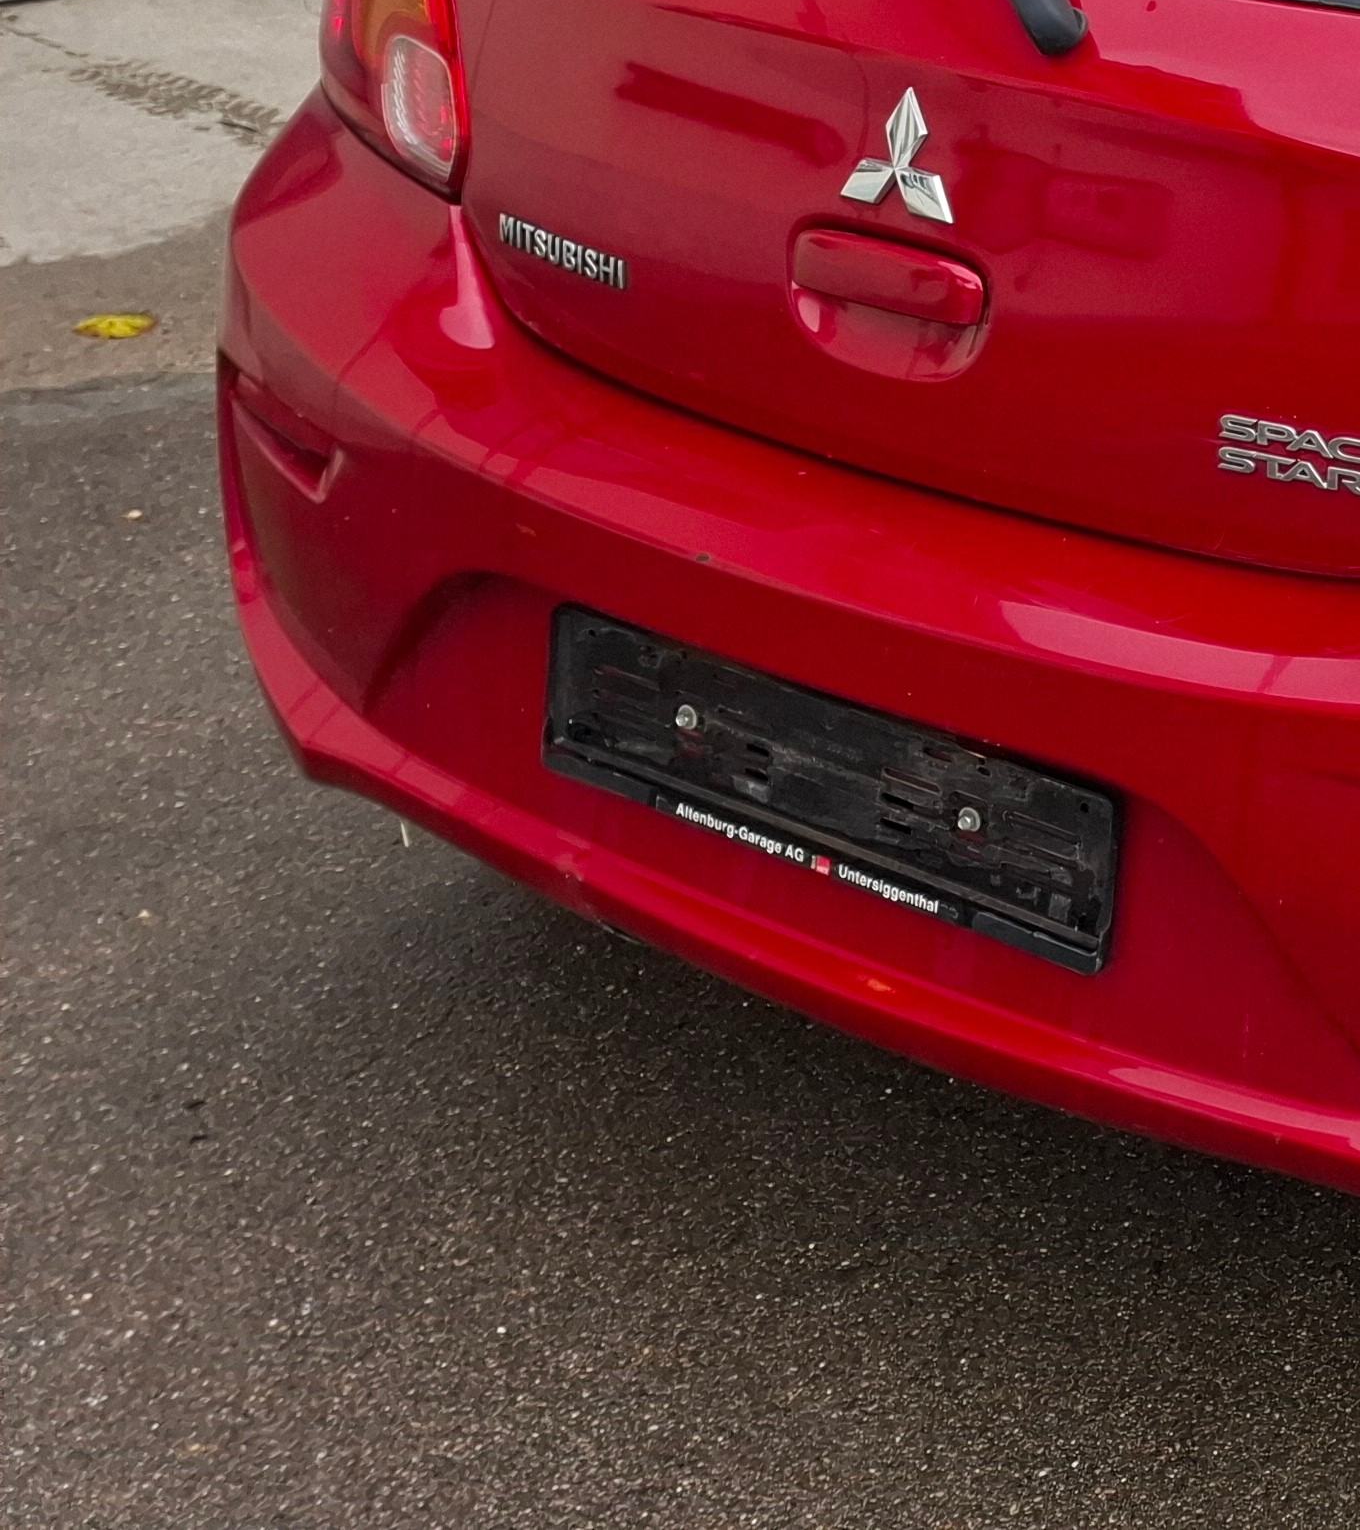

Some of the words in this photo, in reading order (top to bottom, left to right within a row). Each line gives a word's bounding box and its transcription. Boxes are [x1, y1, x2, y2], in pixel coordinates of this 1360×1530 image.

[499, 213, 624, 289] MITSUBISHI
[676, 802, 782, 855] Altenburg-Garage
[785, 844, 805, 863] AG
[838, 864, 939, 914] Untersiggenthal
